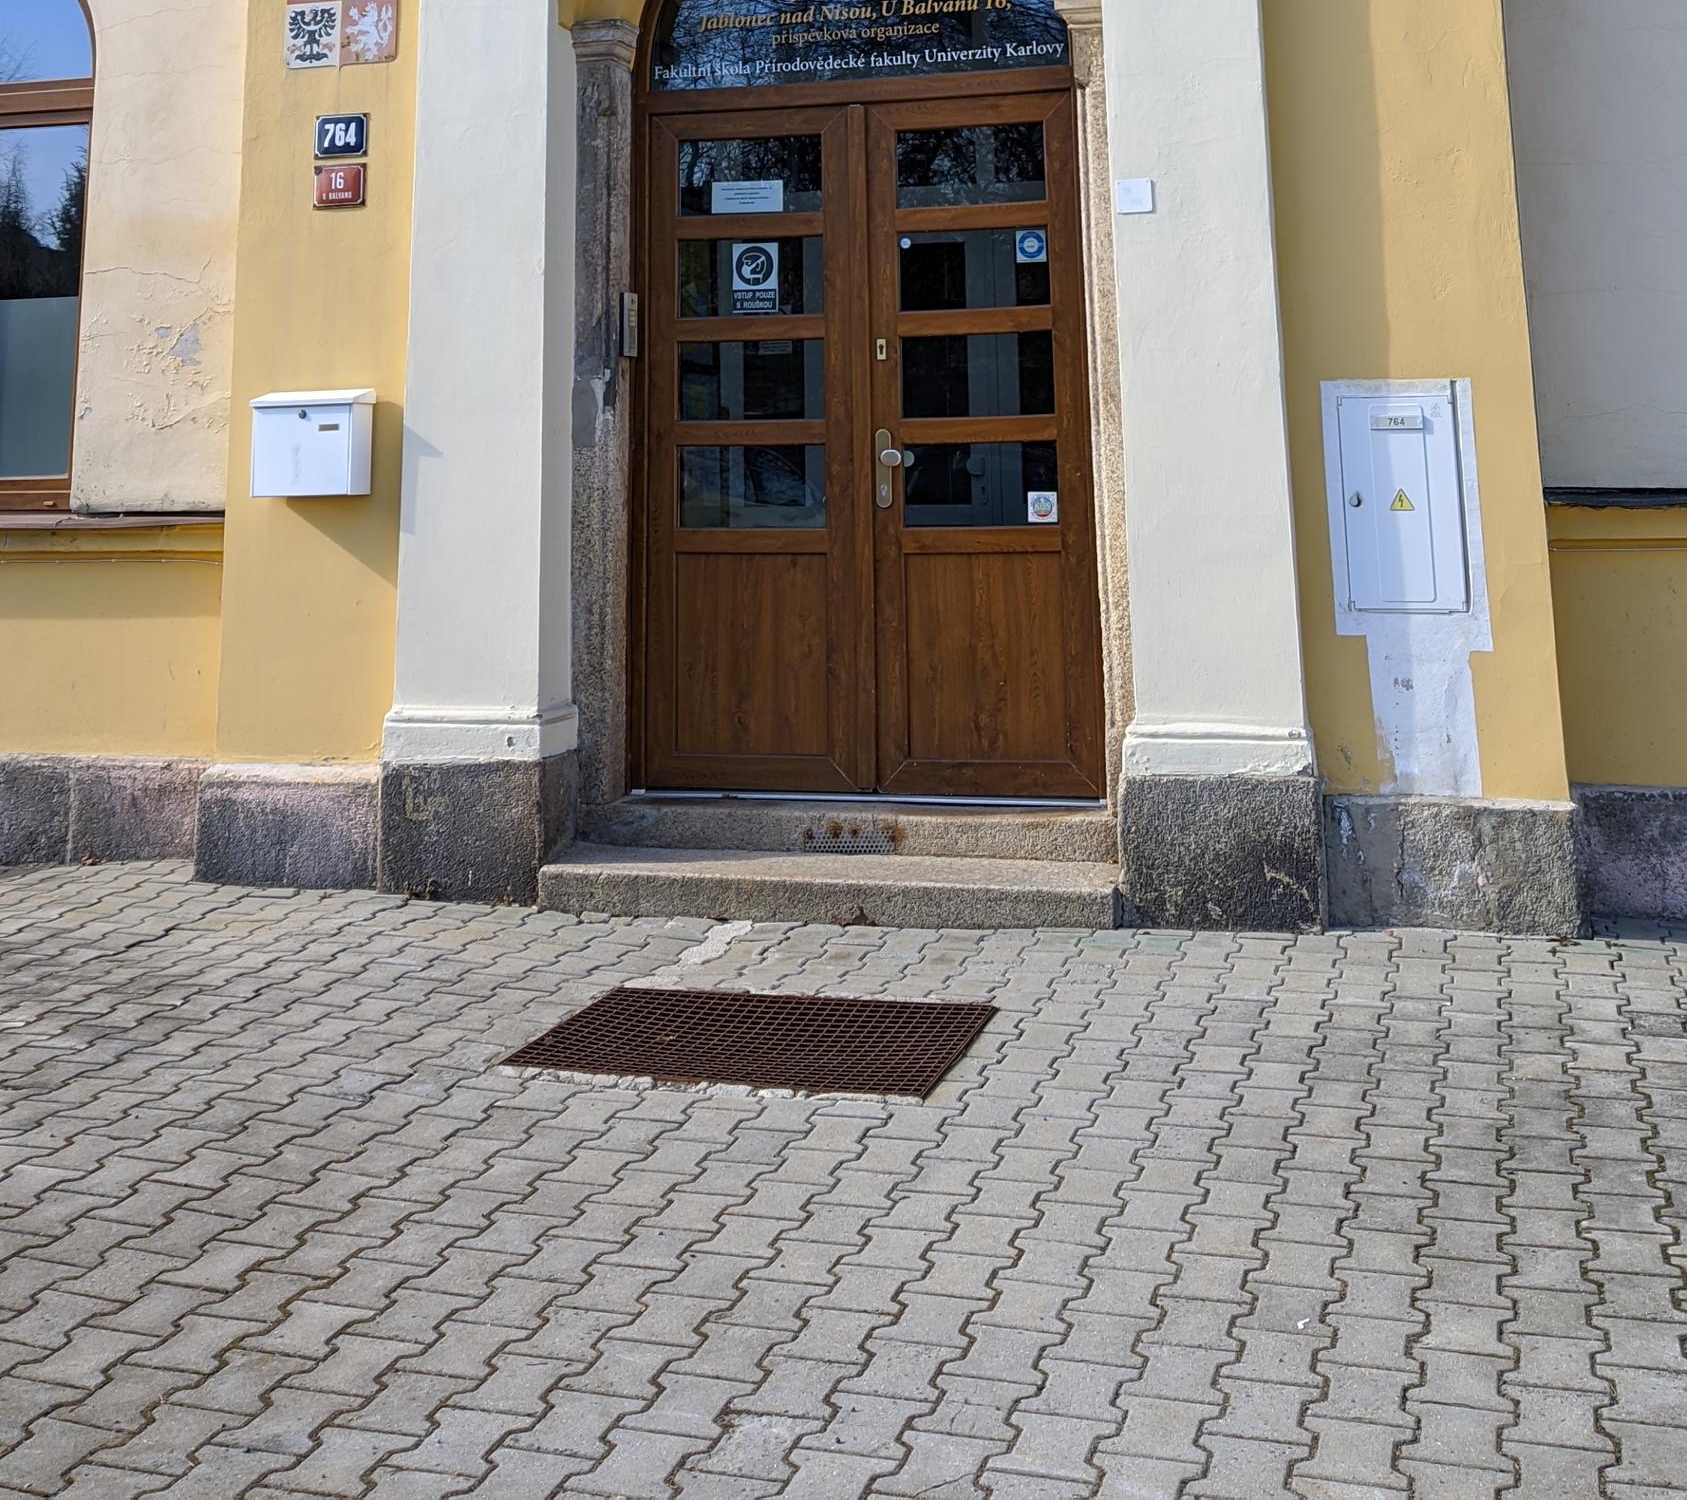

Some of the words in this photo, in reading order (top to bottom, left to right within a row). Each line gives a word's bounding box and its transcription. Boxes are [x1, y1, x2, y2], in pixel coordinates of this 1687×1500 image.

[700, 14, 774, 32] Jablonec
[780, 5, 815, 25] nad
[819, 3, 876, 22] Nisou,
[880, 0, 898, 17] U
[771, 25, 858, 49] příspěvková
[861, 21, 940, 42] organizace
[653, 62, 712, 80] Fakultní
[715, 59, 751, 77] škola
[755, 52, 866, 74] Přírodovědecké
[870, 50, 921, 69] fakulty
[925, 44, 1002, 63] Univerzity
[1005, 40, 1065, 58] Karlovy
[323, 122, 356, 147] 764
[330, 172, 345, 190] 16
[328, 191, 352, 200] BALVANU
[733, 291, 754, 299] VSTUP
[755, 291, 776, 299] POUZE
[743, 300, 773, 309] ROUŠKOU
[1388, 417, 1405, 426] 764
